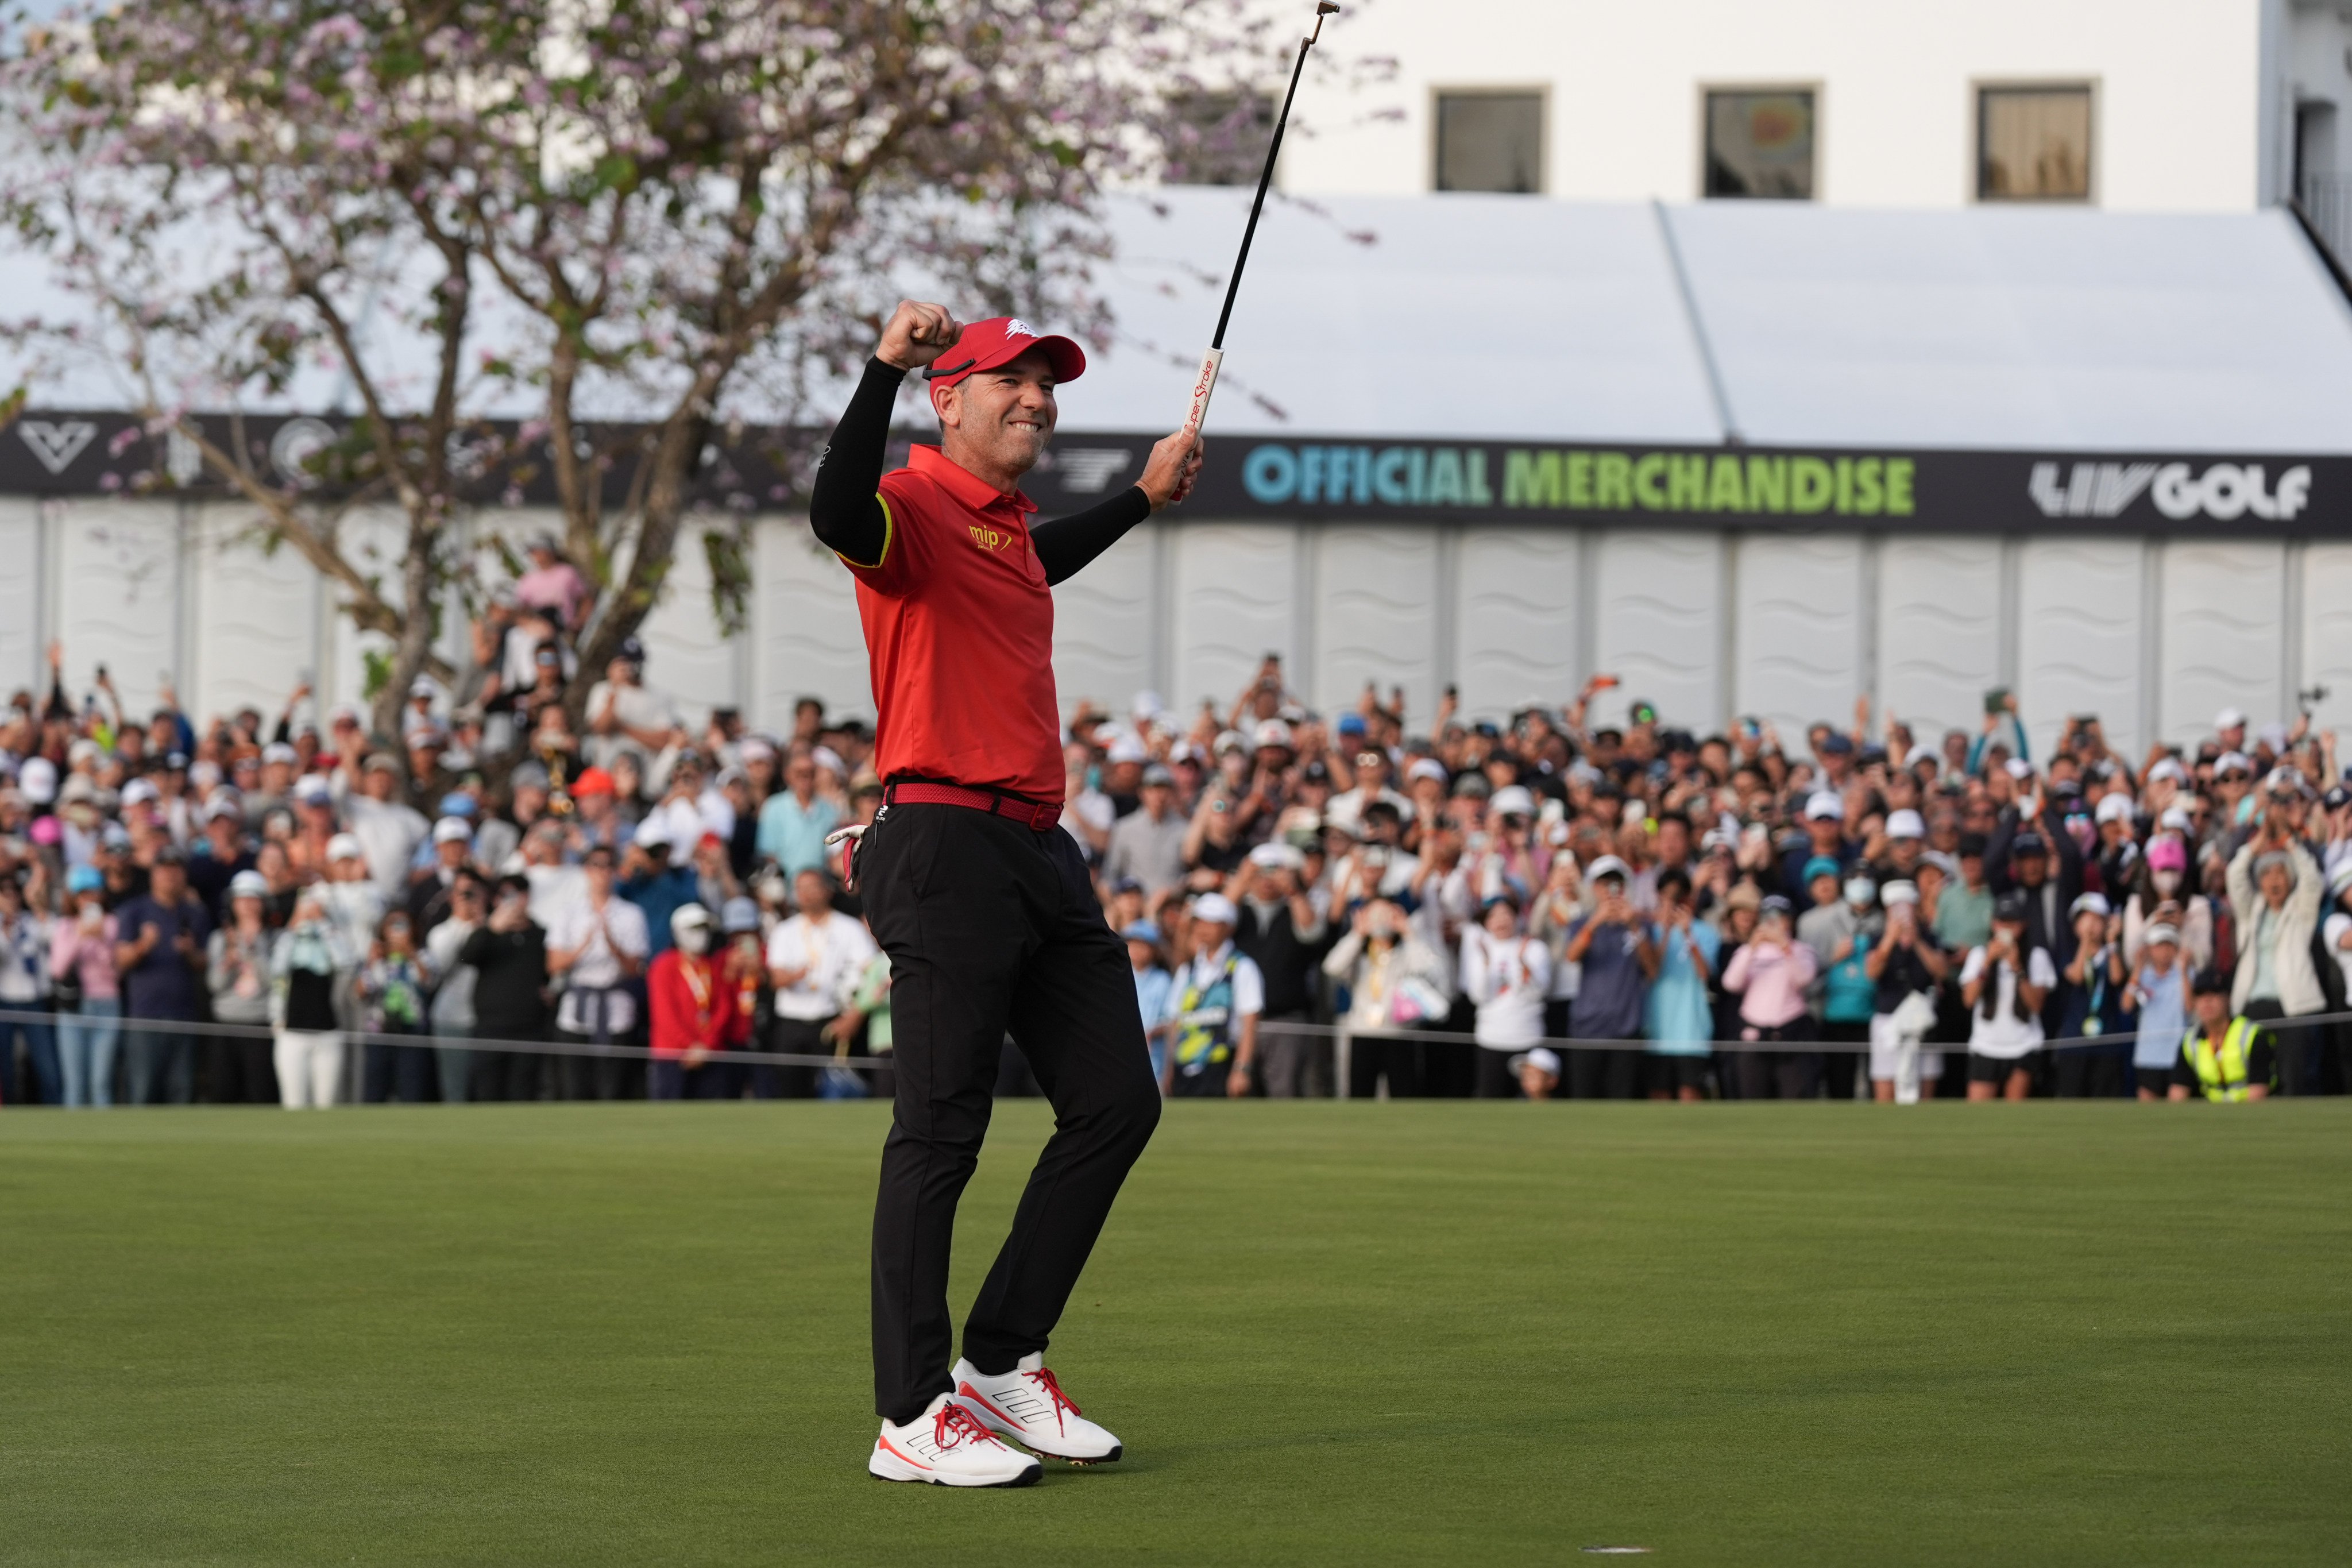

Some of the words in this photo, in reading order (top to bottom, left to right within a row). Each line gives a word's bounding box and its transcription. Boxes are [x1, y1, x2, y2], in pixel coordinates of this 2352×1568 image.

[1243, 444, 1491, 507] OFFICIAL
[1503, 449, 1915, 516] MERCHANDISE
[969, 524, 998, 550] mip
